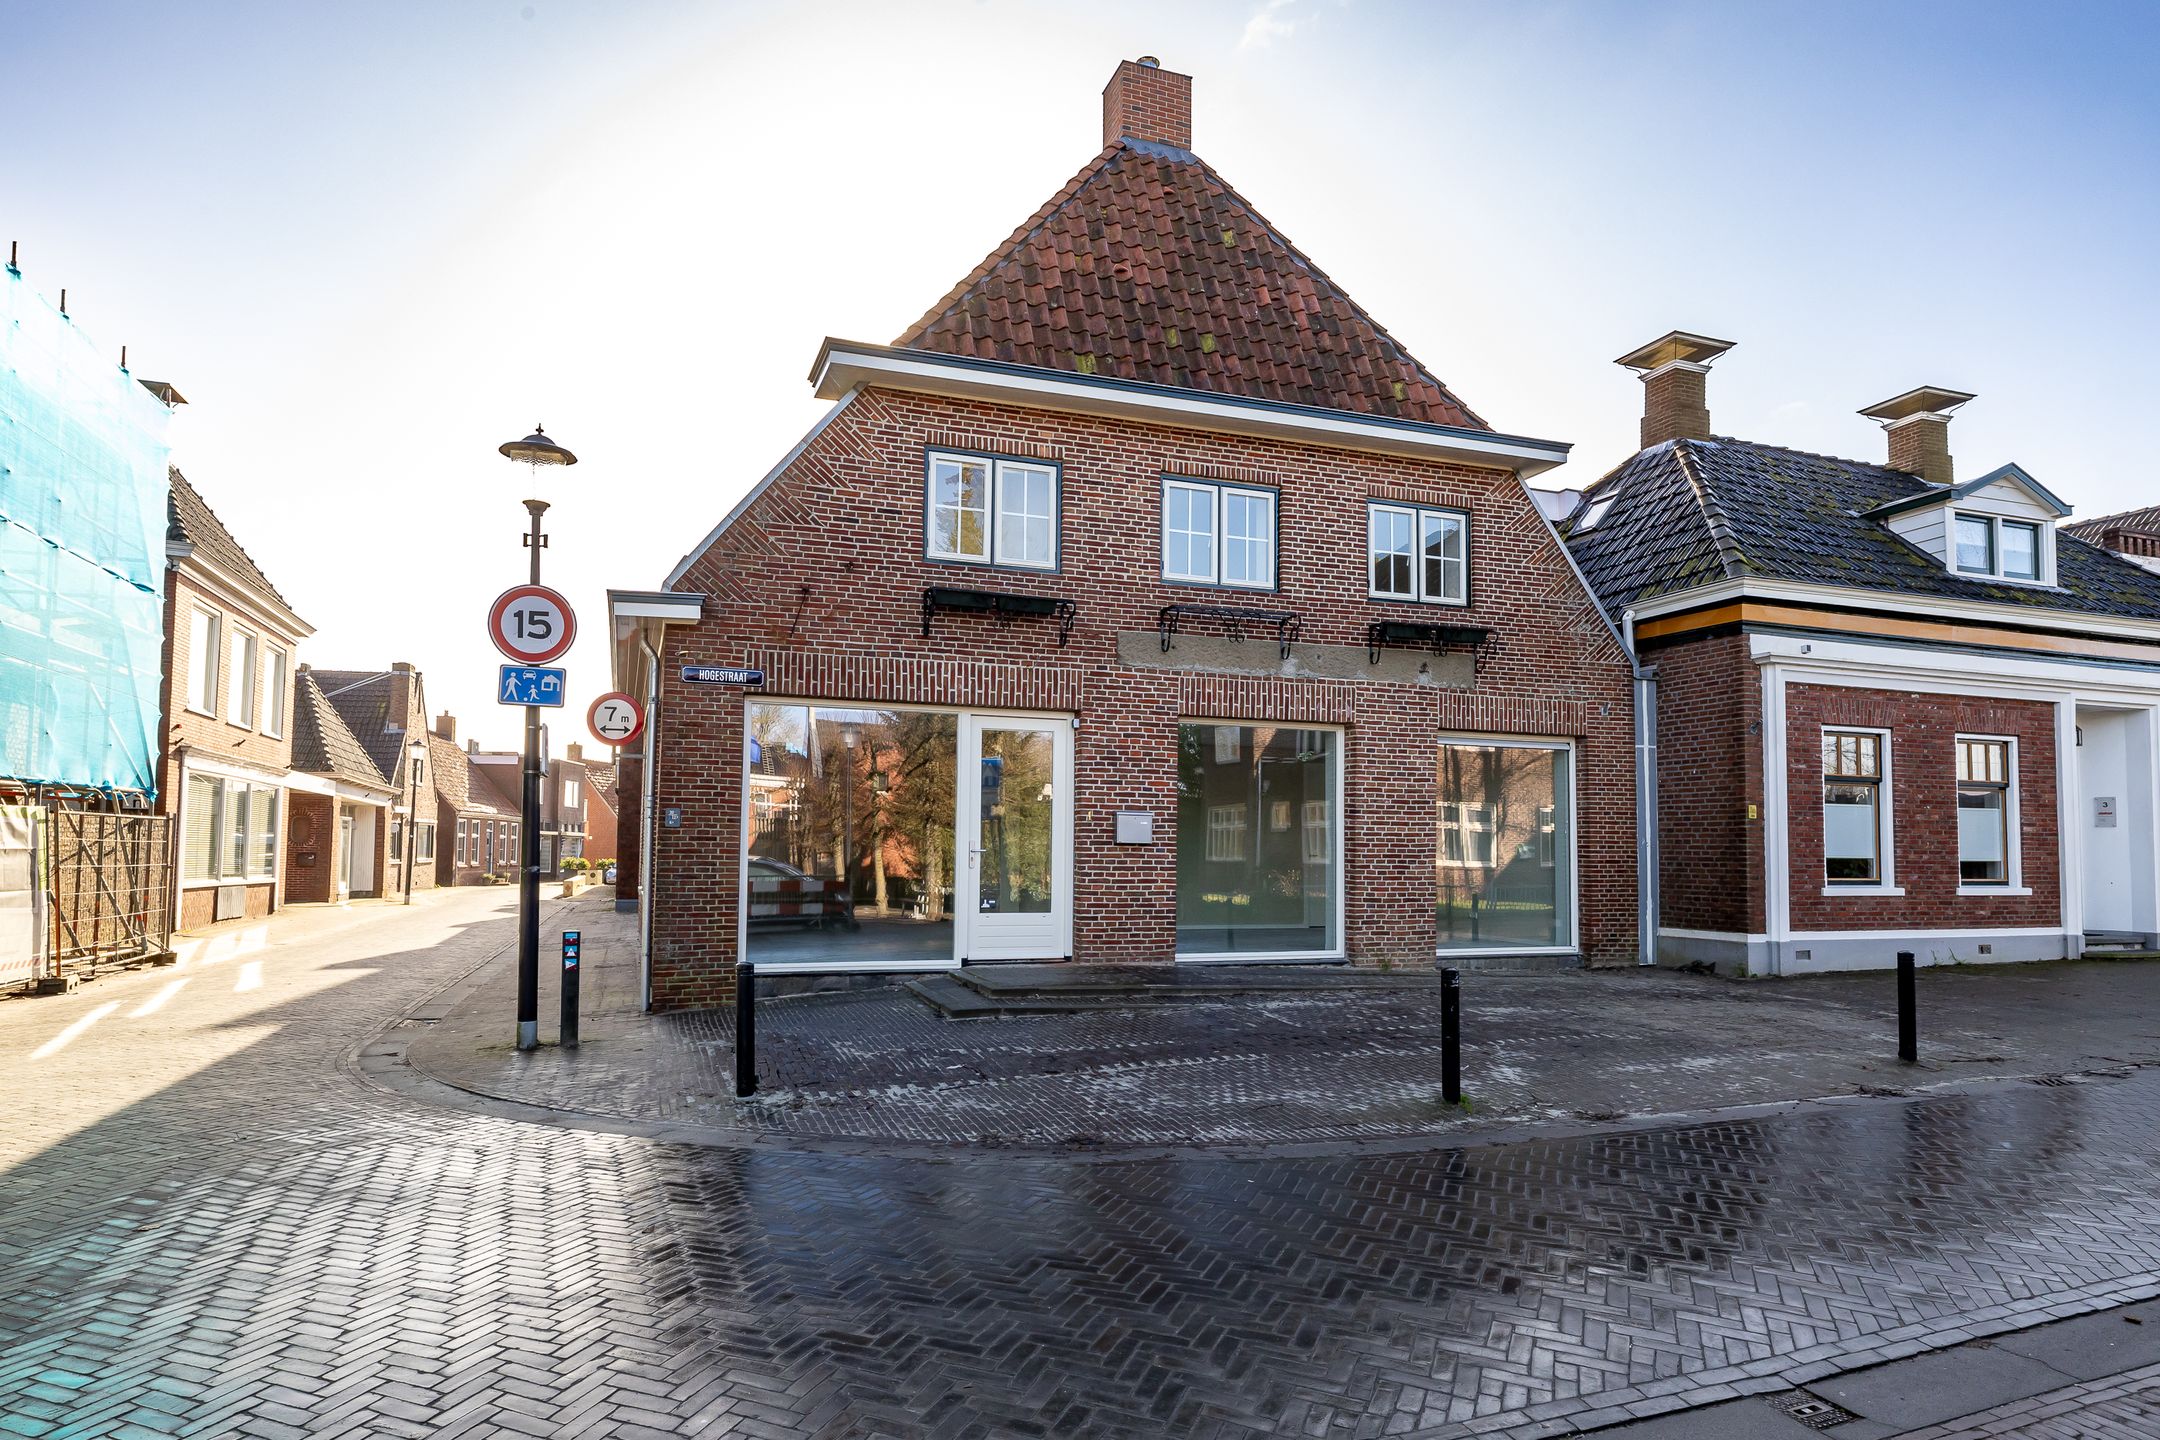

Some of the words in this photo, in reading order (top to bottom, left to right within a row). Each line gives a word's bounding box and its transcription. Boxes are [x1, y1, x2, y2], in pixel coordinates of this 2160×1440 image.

[513, 610, 552, 639] 15
[699, 669, 748, 682] HOGESTRAAT
[604, 706, 617, 721] 7
[621, 715, 630, 723] m
